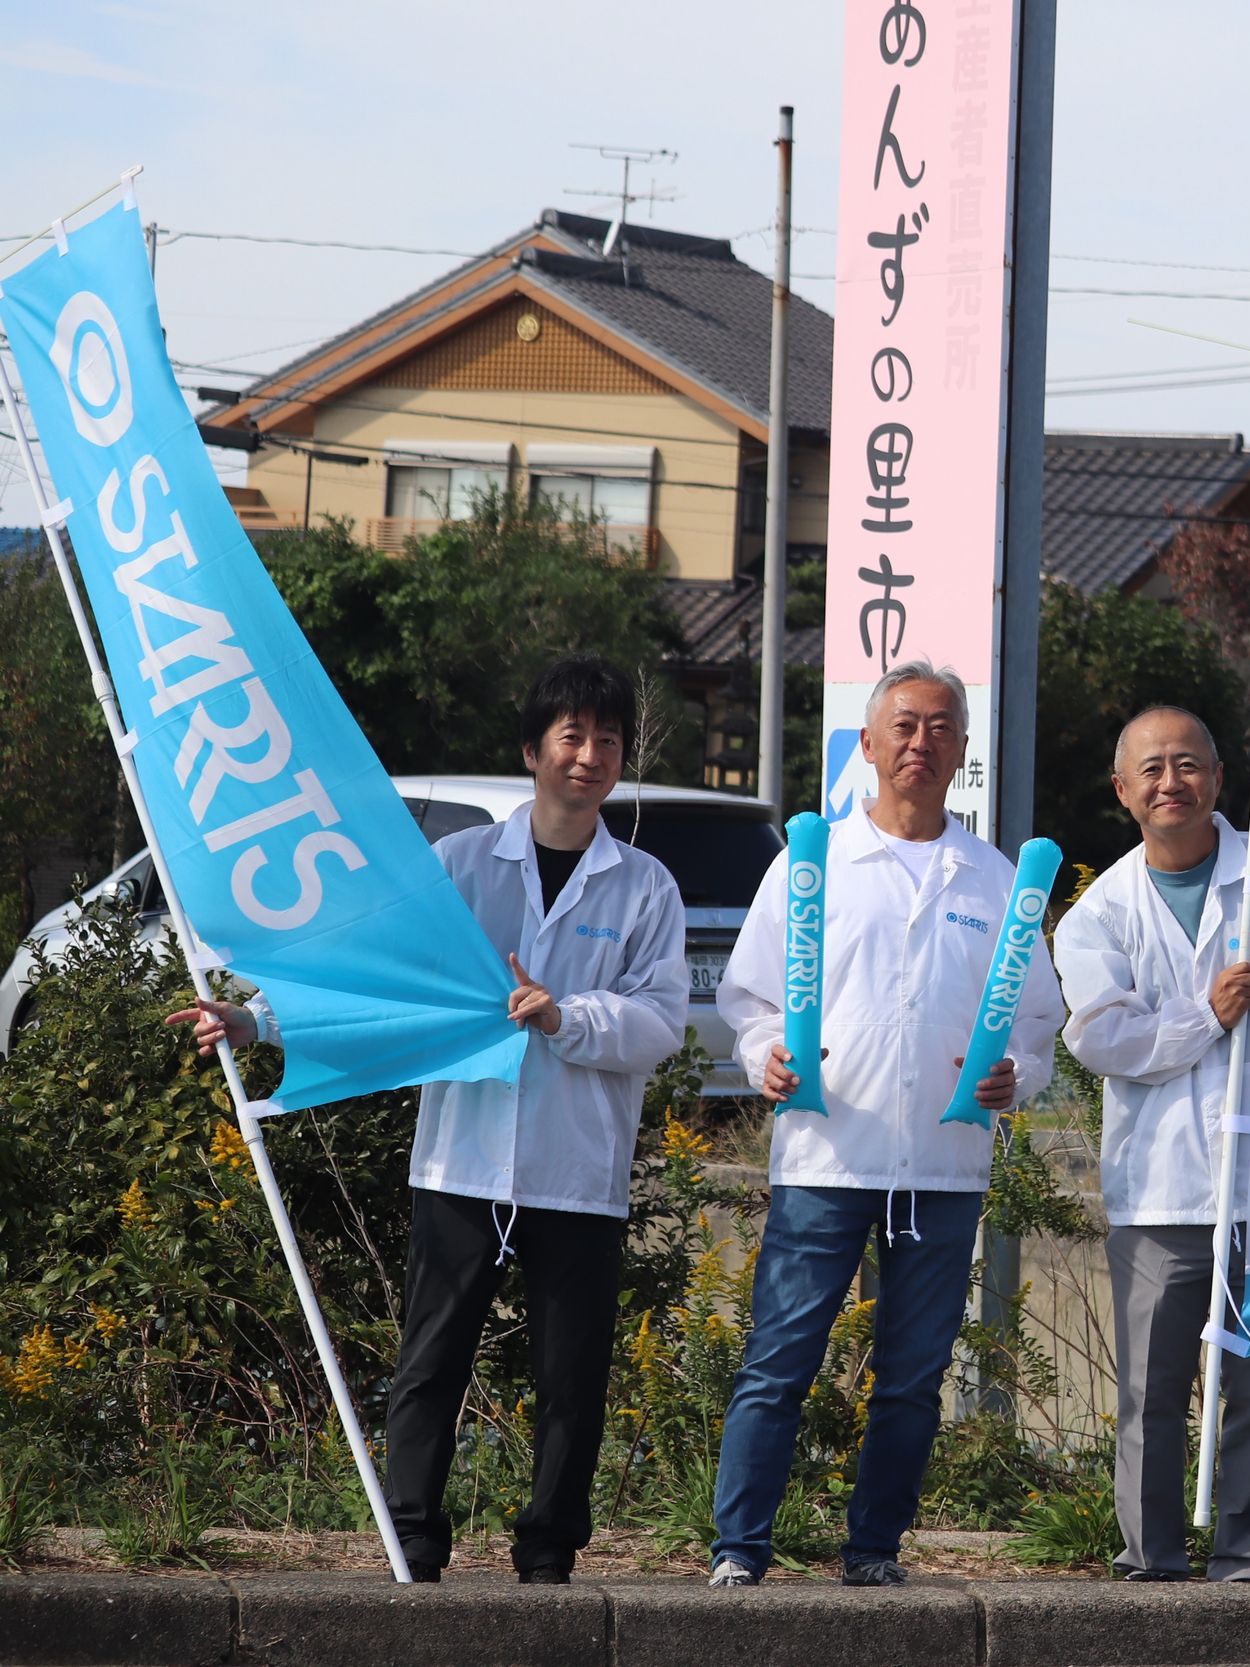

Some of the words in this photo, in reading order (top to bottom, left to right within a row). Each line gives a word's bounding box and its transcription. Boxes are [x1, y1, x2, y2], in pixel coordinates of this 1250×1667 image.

[943, 0, 992, 392] 産者直売所
[98, 453, 368, 931] STARTS
[787, 901, 820, 1014] STARTS
[958, 914, 989, 935] STARTS
[983, 924, 1037, 1033] STARTS
